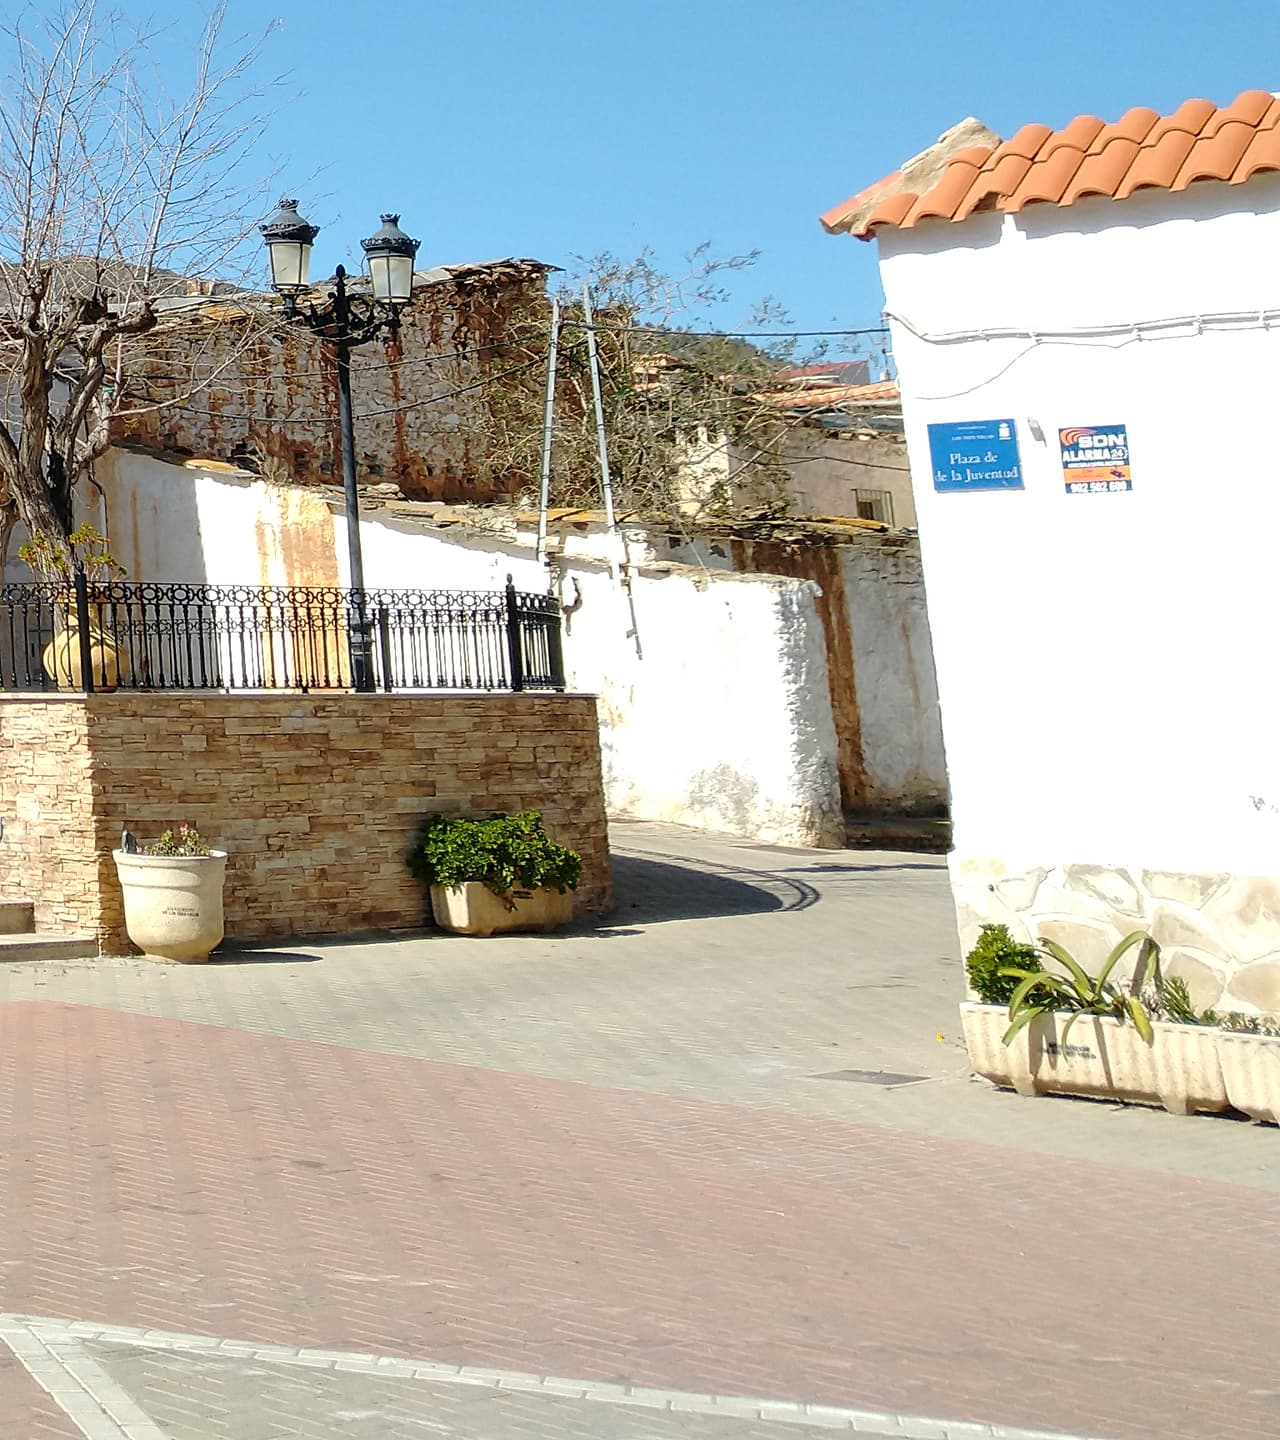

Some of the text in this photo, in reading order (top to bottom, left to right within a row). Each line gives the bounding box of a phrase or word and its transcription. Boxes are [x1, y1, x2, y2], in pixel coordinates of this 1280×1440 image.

[950, 451, 999, 465] Plaza de
[1062, 448, 1111, 462] ALARMA
[935, 466, 1019, 483] de la Juventud
